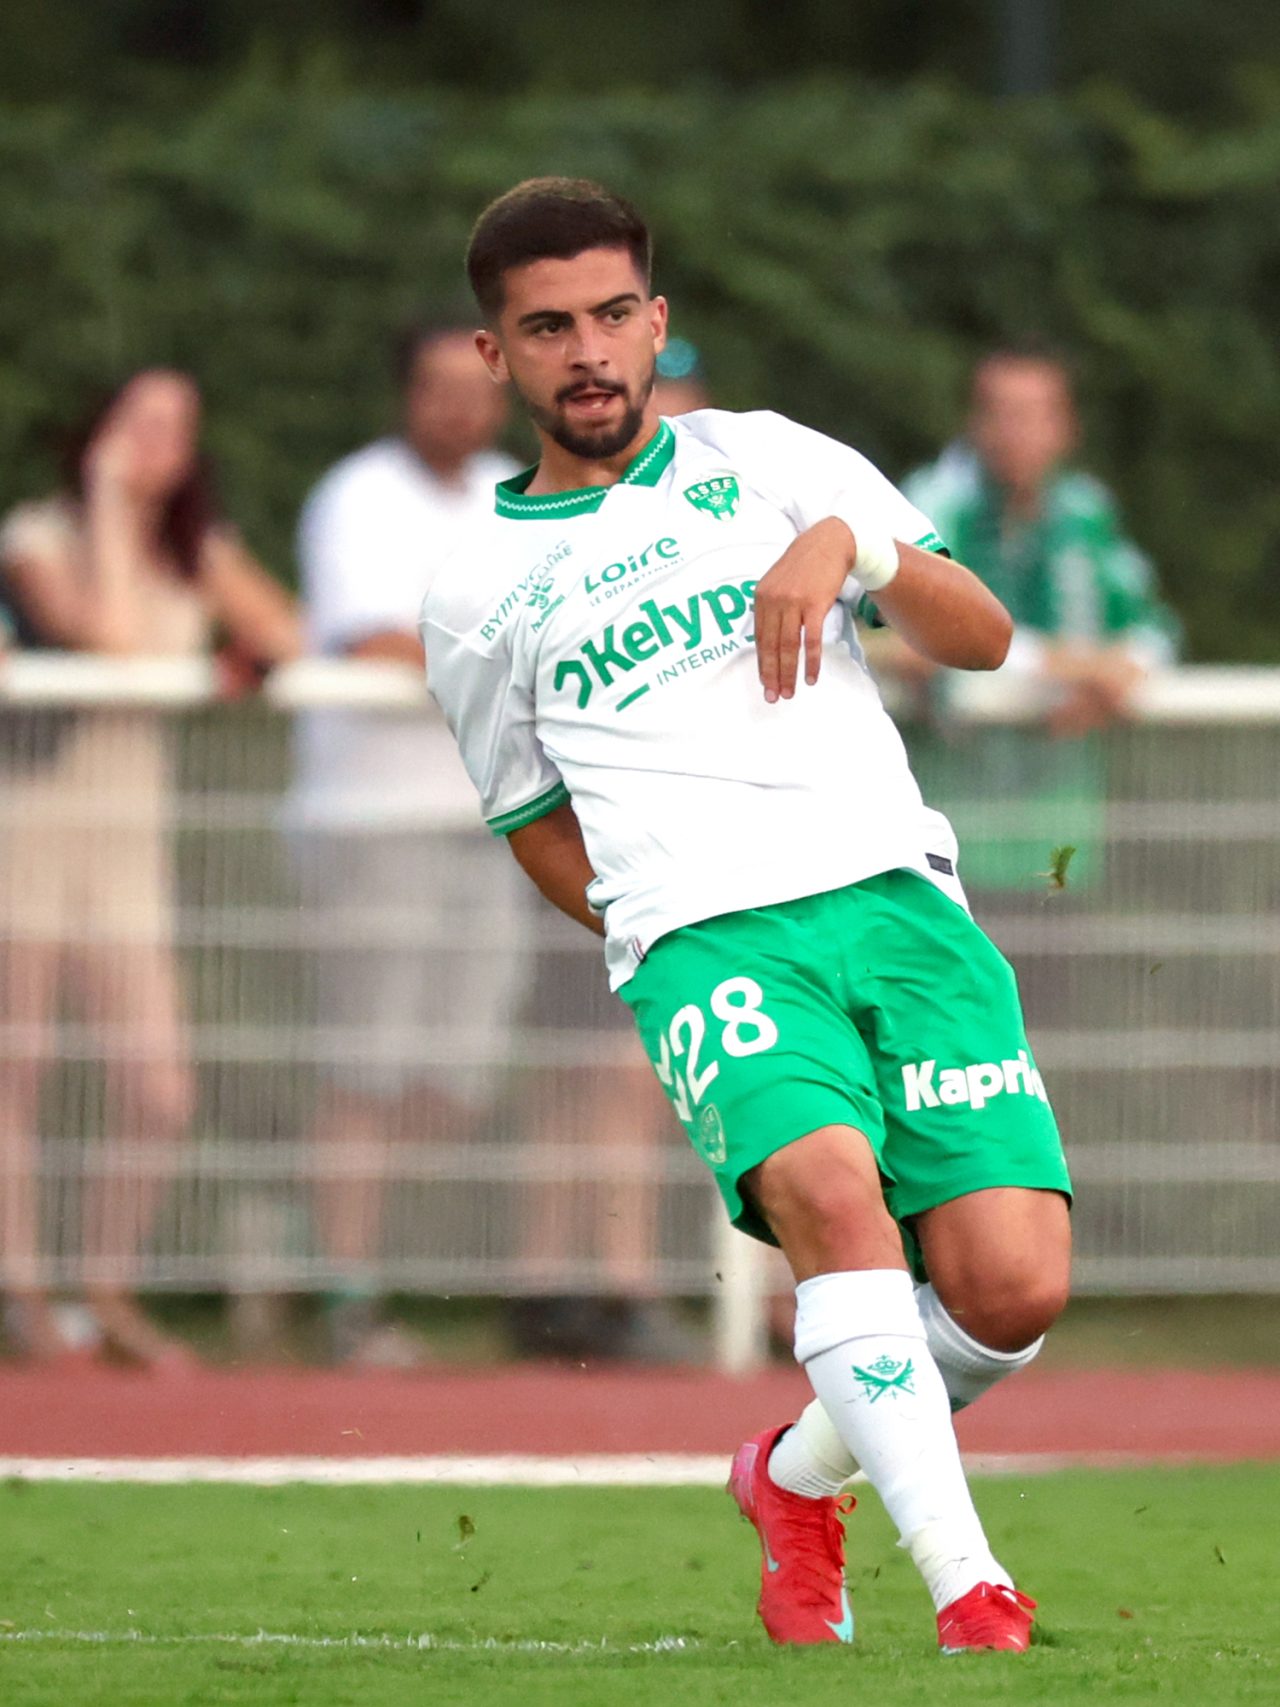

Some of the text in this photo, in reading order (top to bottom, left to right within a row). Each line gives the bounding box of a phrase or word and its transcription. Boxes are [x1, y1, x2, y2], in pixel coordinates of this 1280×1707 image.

[687, 478, 734, 501] ASSE
[656, 639, 740, 686] INTERIM
[669, 976, 778, 1106] 28
